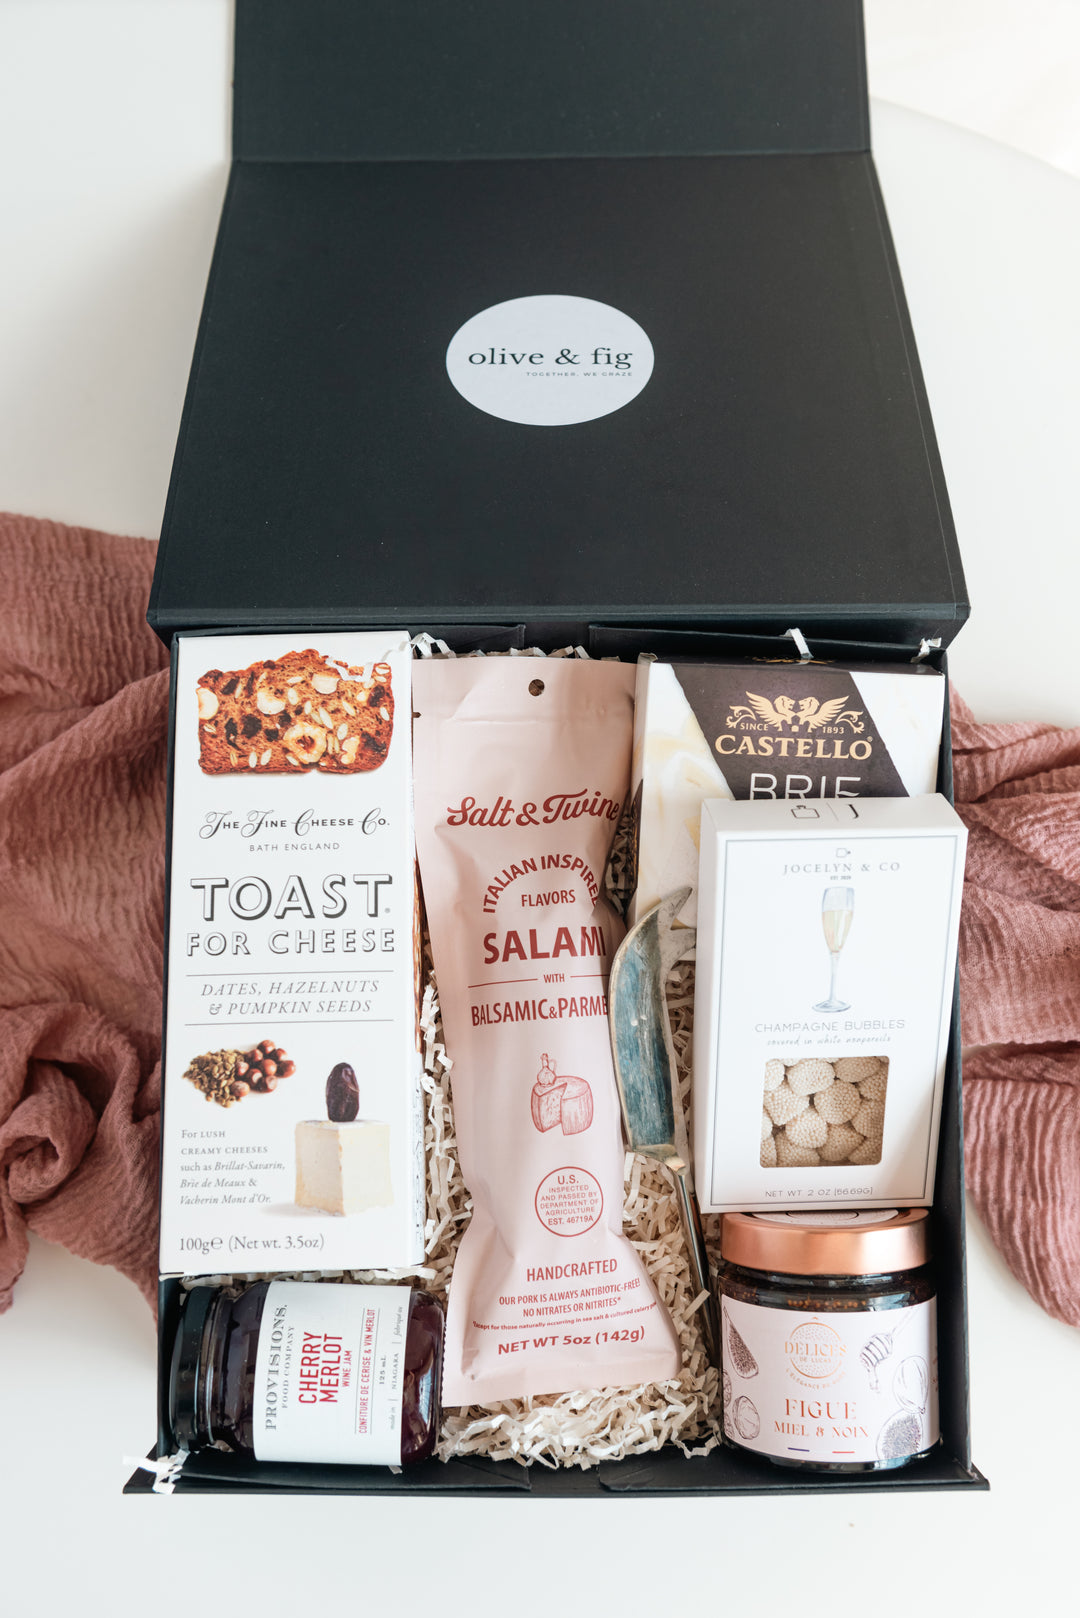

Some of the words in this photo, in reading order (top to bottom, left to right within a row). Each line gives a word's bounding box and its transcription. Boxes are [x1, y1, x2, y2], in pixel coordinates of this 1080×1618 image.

[468, 348, 544, 365] olive
[555, 348, 580, 365] &
[591, 347, 633, 370] fig
[739, 722, 769, 731] SINCE
[822, 726, 845, 734] 1893
[715, 734, 873, 761] CASTELLO
[750, 772, 861, 800] BRIE
[446, 796, 515, 827] Salt
[515, 802, 540, 826] &
[542, 788, 620, 824] Twine
[249, 844, 279, 852] BATH
[284, 842, 340, 851] ENGLAND
[782, 863, 853, 876] JOCELYN
[860, 863, 871, 872] &
[879, 862, 901, 872] CO
[482, 857, 538, 913] ITALIAN
[190, 874, 393, 921] TOAST
[521, 889, 576, 907] FLAVORS
[186, 931, 251, 956] FOR
[268, 928, 395, 954] CHEESE
[483, 926, 607, 965] SALAMI
[543, 973, 565, 983] WITH
[200, 982, 262, 997] DATES,
[268, 980, 380, 995] HAZELNUTS
[208, 1002, 223, 1015] &
[227, 1000, 312, 1015] PUMPKIN
[316, 999, 372, 1013] SEEDS
[754, 1021, 839, 1033] CHAMPAGNE
[844, 1019, 905, 1031] BUBBLES
[181, 1129, 197, 1139] For
[200, 1130, 226, 1139] LUSH
[181, 1147, 222, 1156] CREAMY
[224, 1146, 269, 1154] CHEESES
[180, 1161, 200, 1172] such
[214, 1160, 286, 1172] Brillat-Savarin,
[180, 1178, 200, 1188] Brie
[201, 1178, 212, 1188] de
[214, 1178, 246, 1188] Meaux
[248, 1178, 257, 1187] &
[557, 1174, 579, 1185] U.S.
[541, 1194, 556, 1202] AND
[558, 1192, 586, 1201] PASSED
[548, 1184, 590, 1194] INSPECTED
[765, 1190, 783, 1198] NET
[787, 1189, 802, 1197] WT
[807, 1189, 814, 1197] 2
[817, 1188, 831, 1196] OZ
[180, 1194, 219, 1205] Vacherin
[221, 1194, 247, 1205] Mont
[540, 1199, 587, 1210] DEPARTMENT
[545, 1206, 595, 1216] AGRICULTURE
[548, 1217, 565, 1226] EST.
[566, 1215, 594, 1223] 46719A
[228, 1234, 259, 1253] (Net
[262, 1238, 281, 1249] wt.
[285, 1233, 325, 1251] 3.5oz)
[527, 1258, 618, 1282] HANDCRAFTED
[499, 1296, 516, 1306] OUR
[517, 1294, 538, 1304] PORK
[540, 1293, 548, 1303] IS
[549, 1290, 579, 1303] ALWAYS
[580, 1278, 641, 1297] ANTIBIOTIC-FREE!
[523, 1308, 535, 1317] NO
[536, 1304, 571, 1316] NITRATES
[573, 1302, 584, 1312] OR
[365, 1308, 376, 1333] MERLOT
[519, 1321, 546, 1330] naturally
[610, 1308, 634, 1318] cultured
[363, 1334, 373, 1346] VIN
[498, 1338, 530, 1355] NET
[533, 1335, 559, 1347] WT
[563, 1335, 592, 1346] 5oz
[595, 1326, 645, 1345] (142g)
[283, 1325, 295, 1377] COMPANY
[343, 1350, 352, 1366] JAM
[298, 1331, 322, 1404] CHERRY
[319, 1333, 343, 1403] MERLOT
[361, 1356, 371, 1383] CERISE
[379, 1355, 387, 1368] mL
[342, 1368, 351, 1387] WINE
[391, 1352, 399, 1390] NIAGARA
[281, 1379, 289, 1409] FOOD
[360, 1385, 369, 1395] DE
[358, 1397, 368, 1434] CONFITURE
[785, 1398, 857, 1420] FIGUE
[774, 1420, 809, 1436] MIEL
[815, 1426, 825, 1437] &
